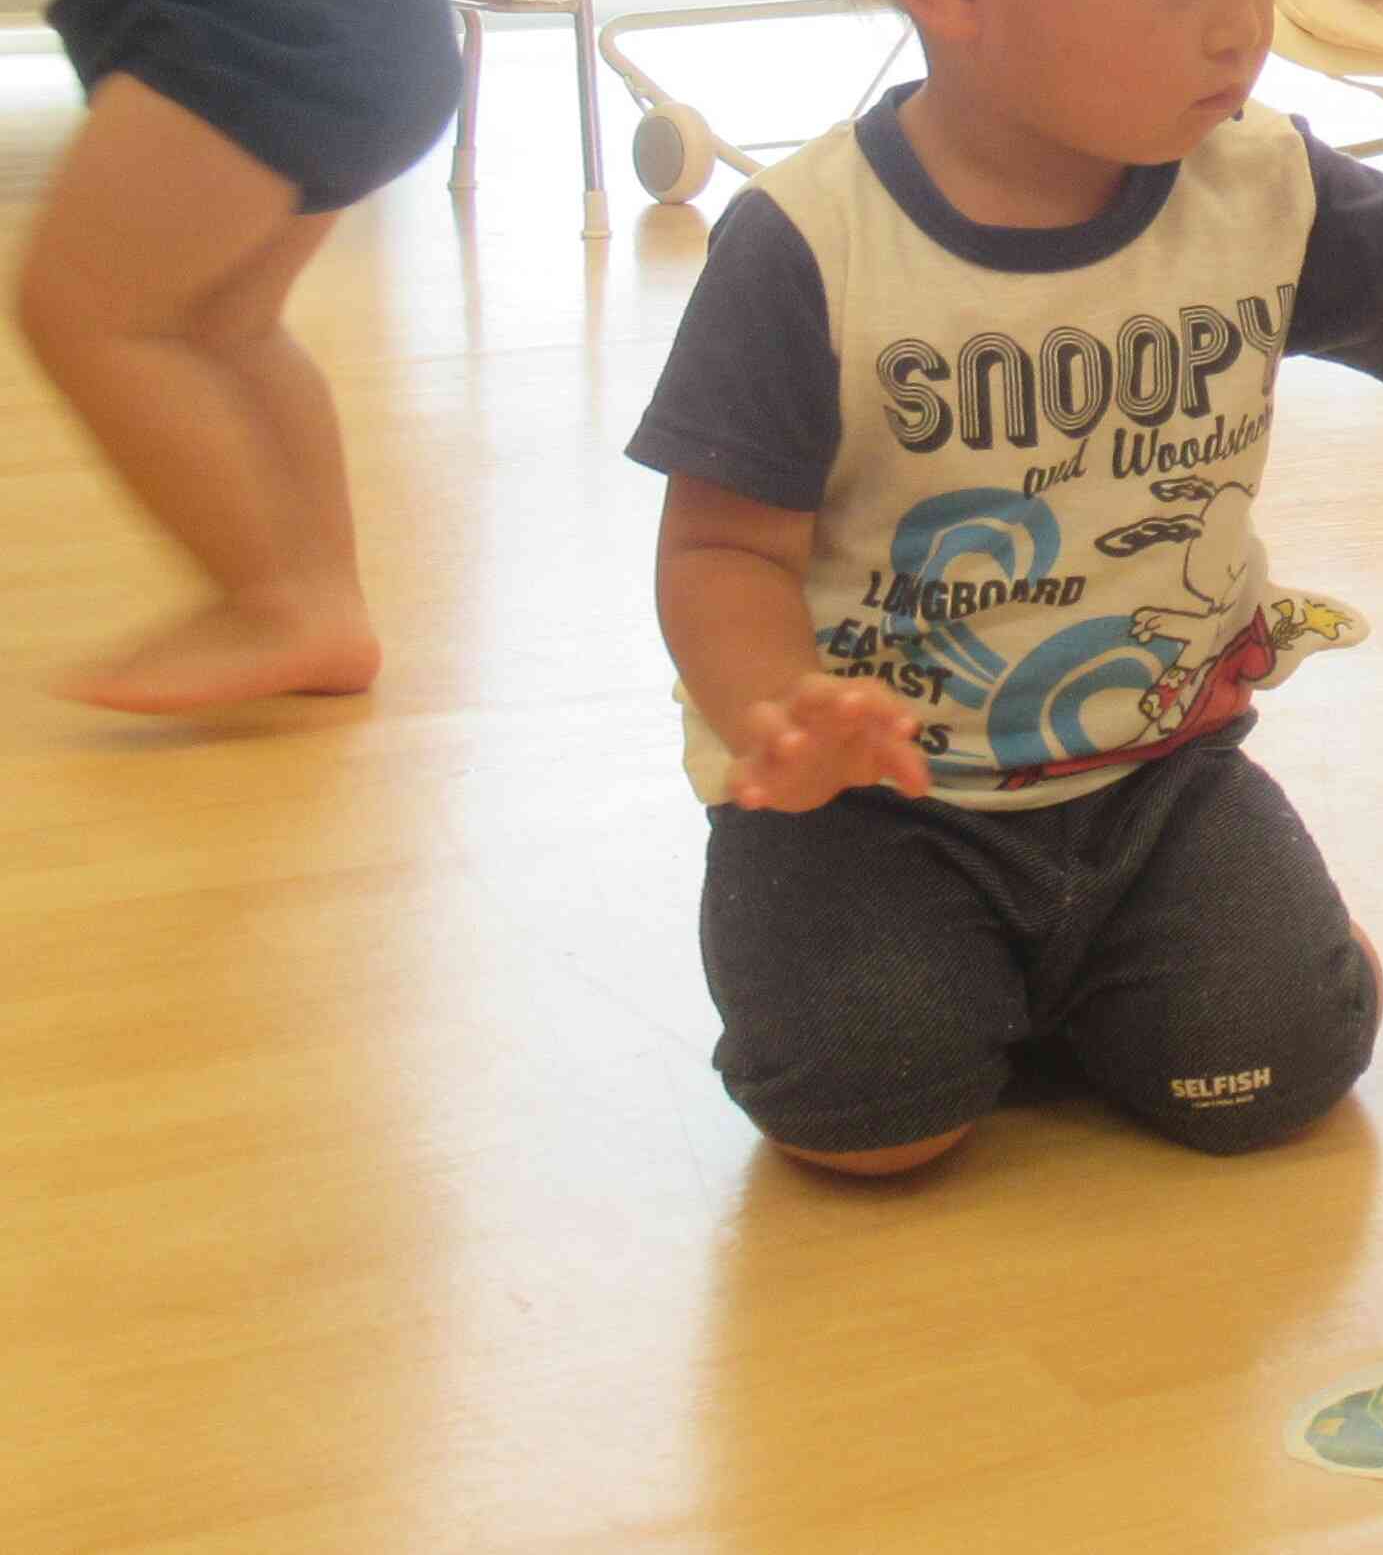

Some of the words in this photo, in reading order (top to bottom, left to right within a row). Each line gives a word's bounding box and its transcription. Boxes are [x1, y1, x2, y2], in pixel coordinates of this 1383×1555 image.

[876, 283, 1295, 453] SNOOPY
[1024, 438, 1088, 500] and
[861, 571, 1087, 622] LONGBOARD
[829, 661, 953, 705] OAST
[1170, 1067, 1272, 1099] SELFISH
